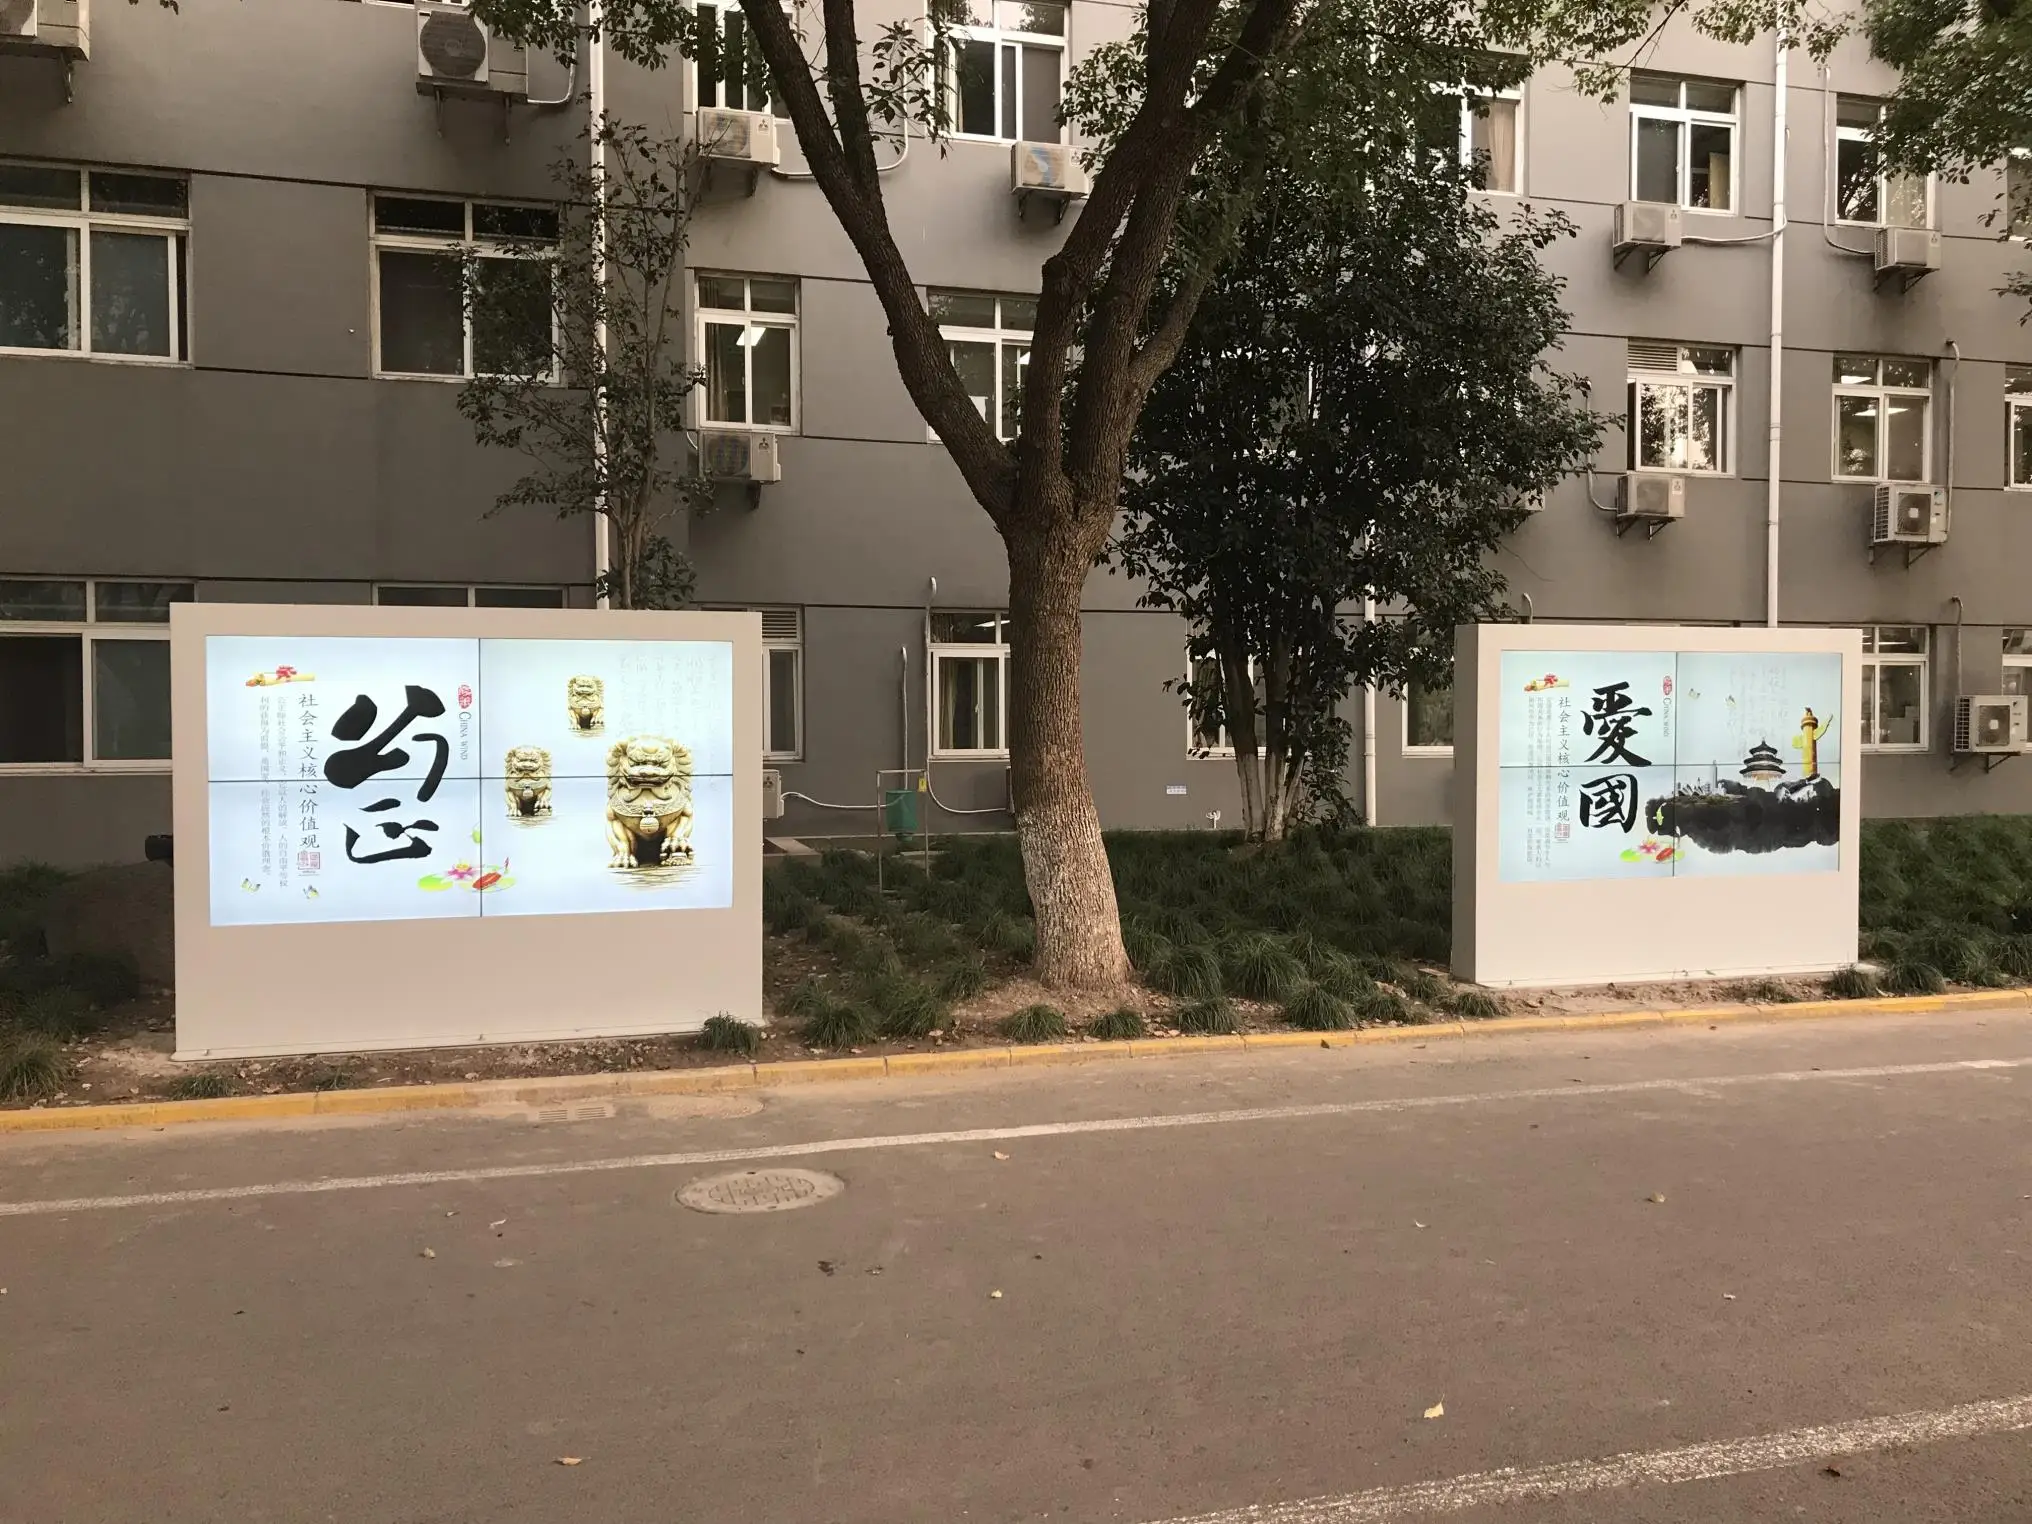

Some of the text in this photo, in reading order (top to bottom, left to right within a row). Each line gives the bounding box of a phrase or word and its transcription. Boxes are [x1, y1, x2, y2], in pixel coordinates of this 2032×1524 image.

[298, 693, 320, 849] 社会主义核心价值观
[458, 711, 472, 738] CHINA
[1556, 696, 1571, 822] 社会主义核心价值观
